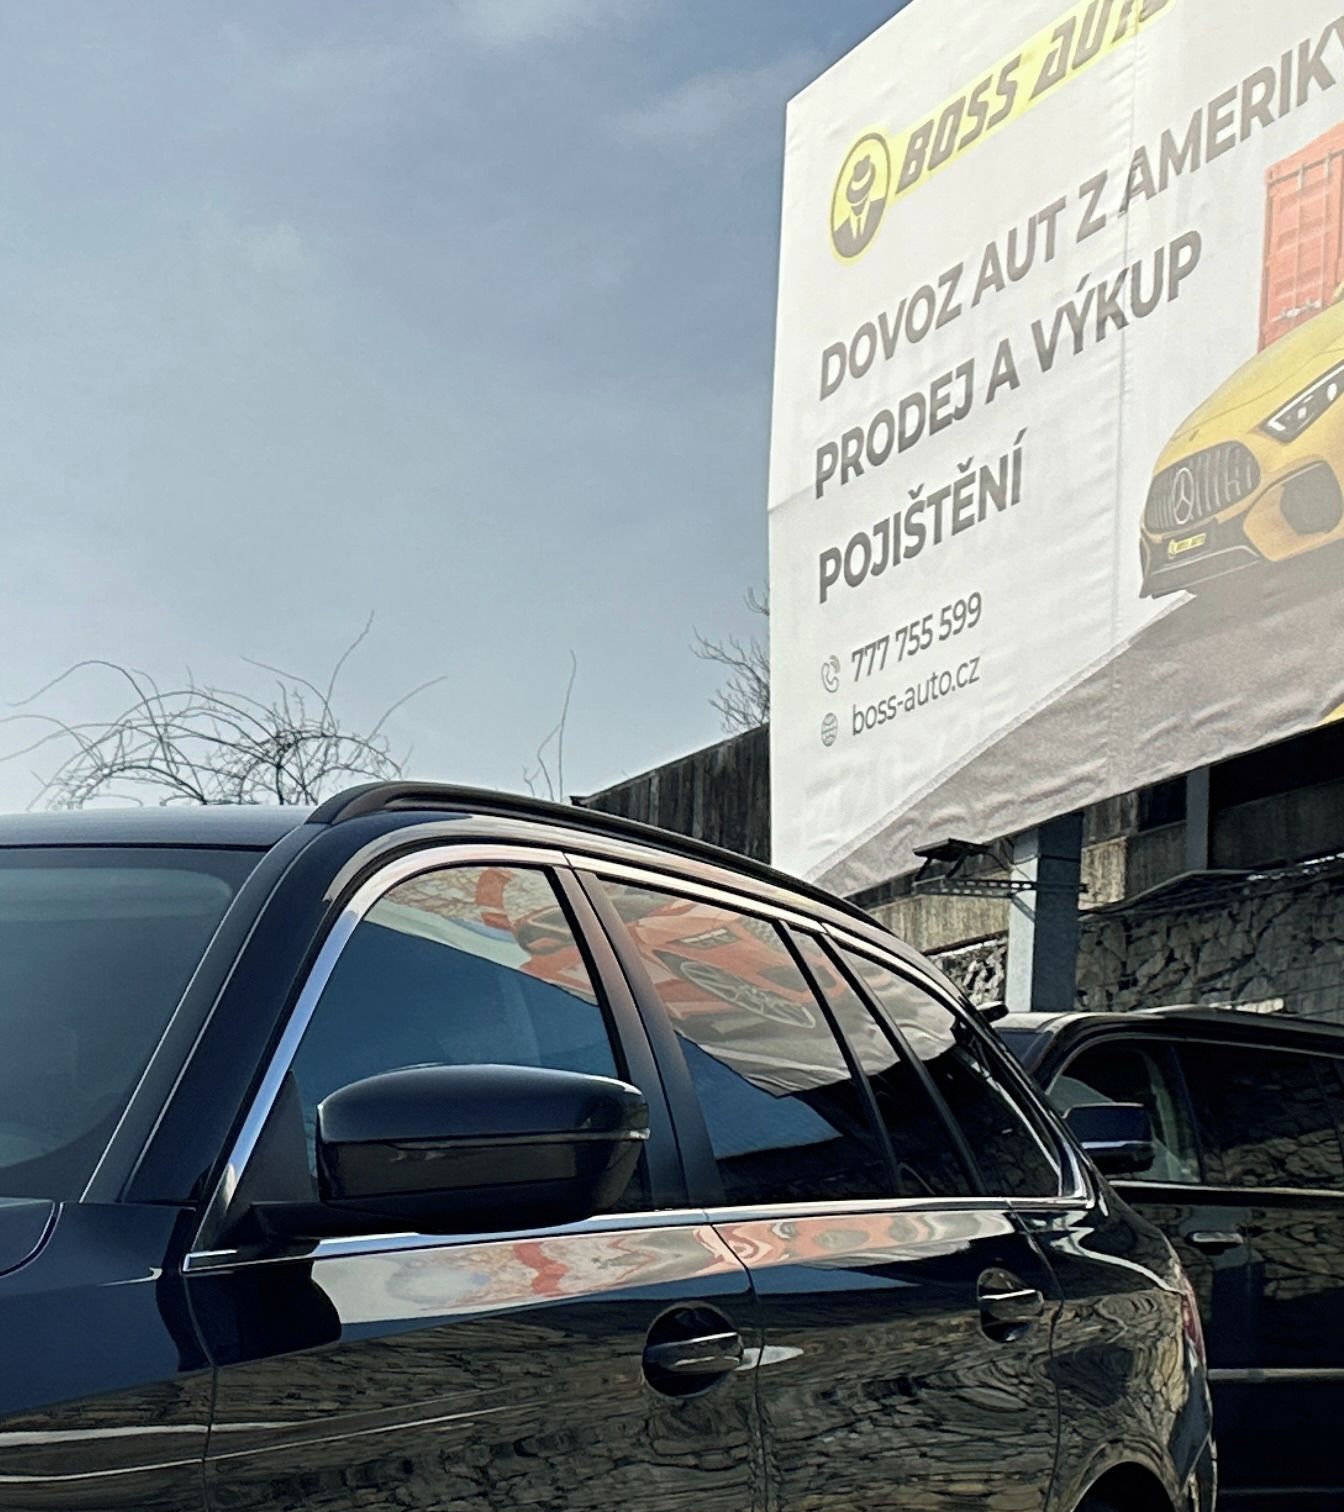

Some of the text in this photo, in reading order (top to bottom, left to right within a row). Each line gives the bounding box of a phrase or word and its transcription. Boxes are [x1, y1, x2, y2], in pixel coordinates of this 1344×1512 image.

[895, 53, 1022, 196] BOSS
[814, 229, 1203, 500] PRODEJ A VÝKUP
[819, 263, 964, 401] DOVOZ
[971, 196, 1067, 308] AUT
[1076, 169, 1109, 245] Z
[818, 427, 1028, 604] POJIŠTĚNÍ
[851, 591, 982, 682] 777 755 599
[852, 656, 981, 736] boss-auto.cz
